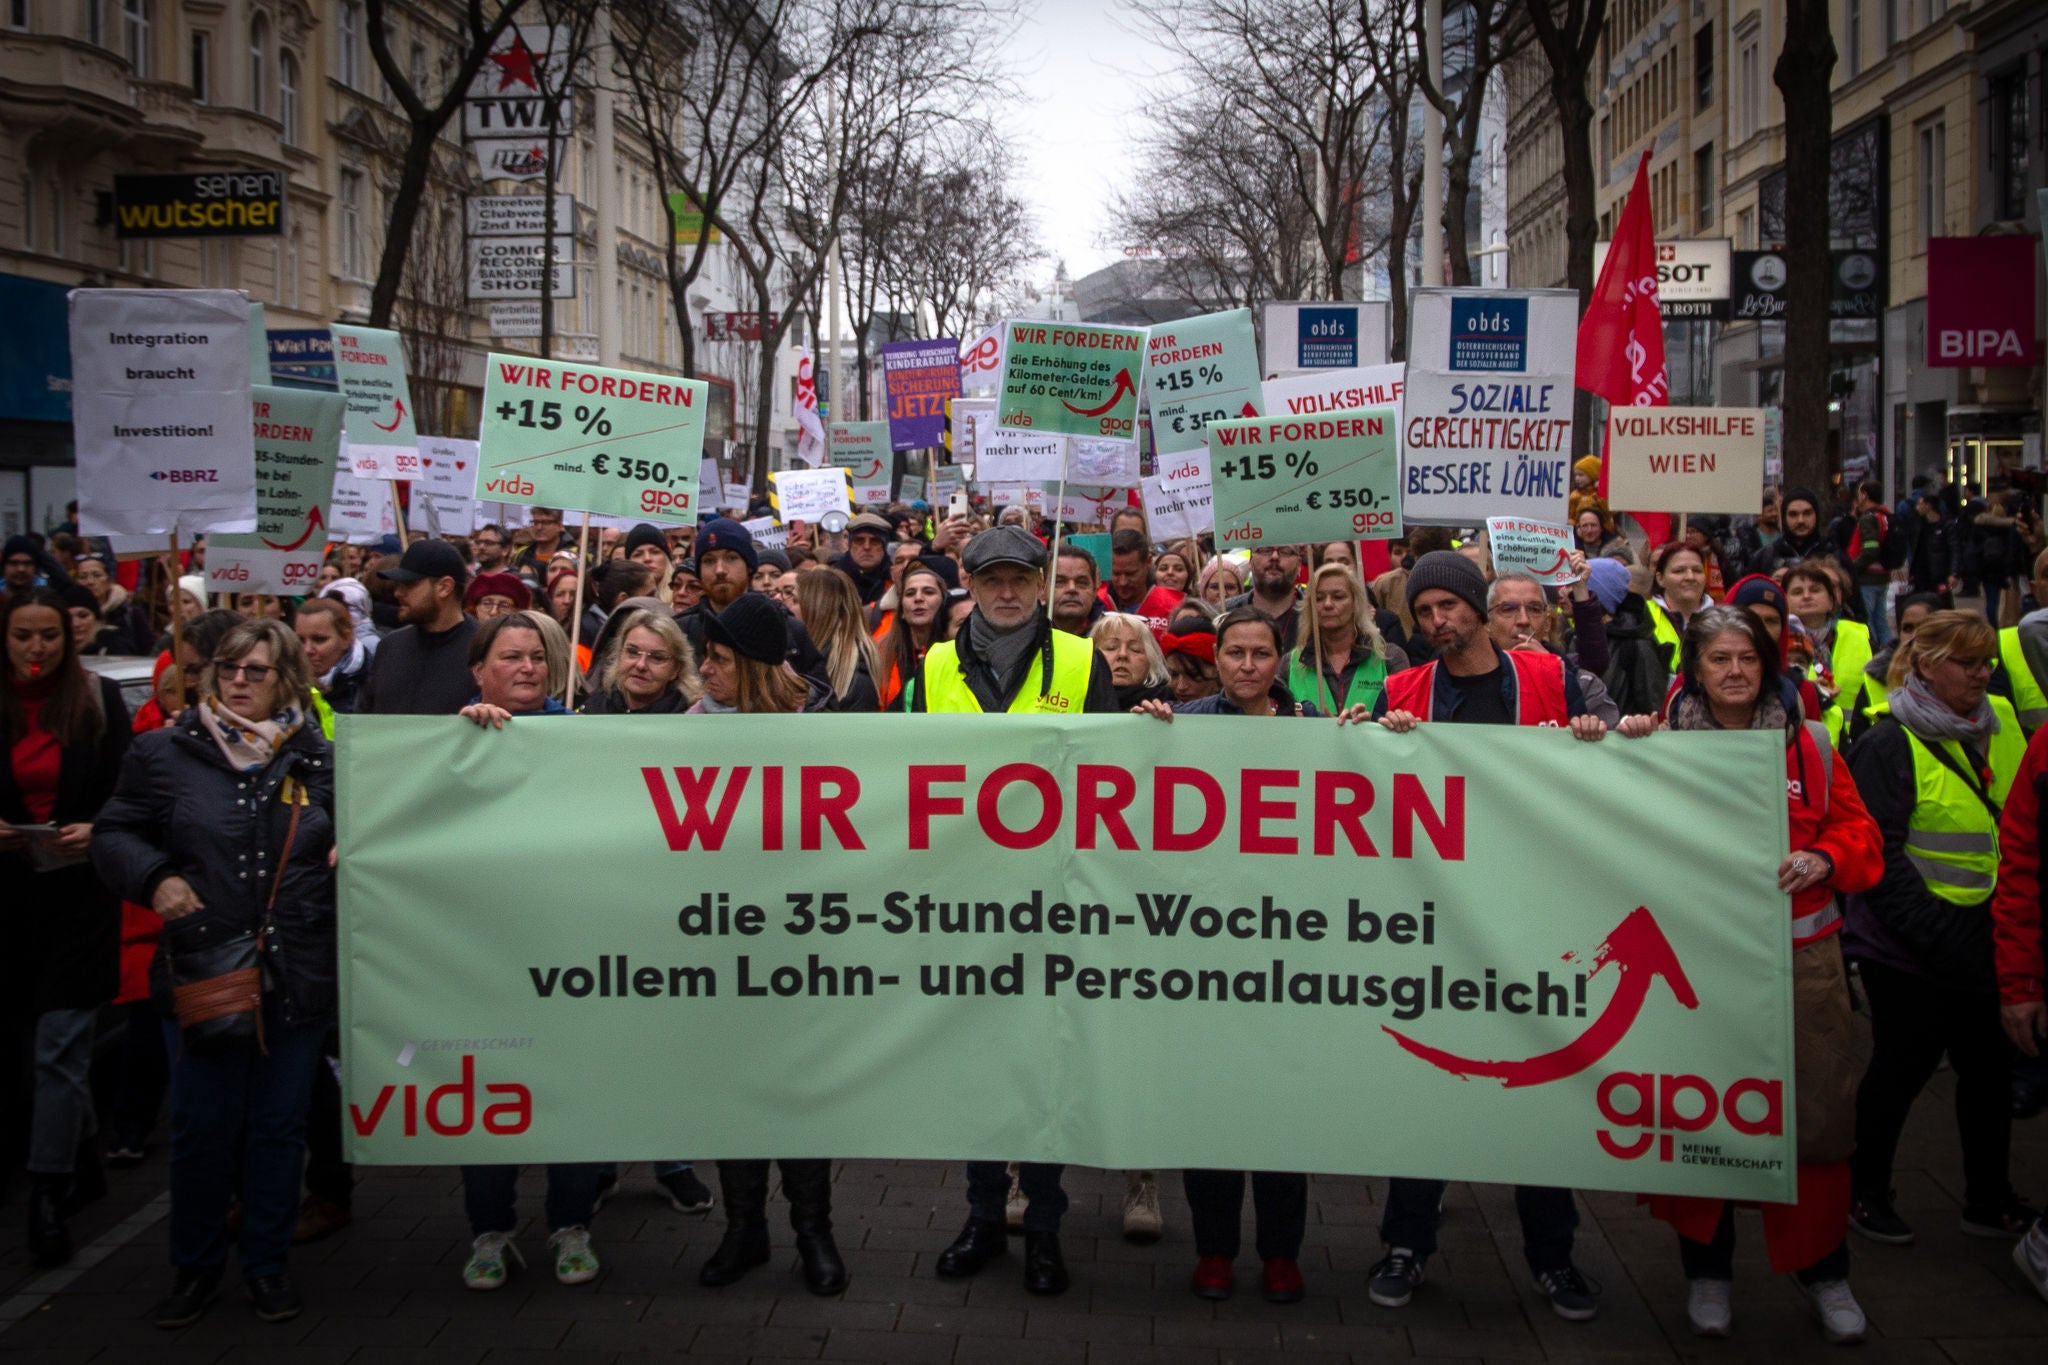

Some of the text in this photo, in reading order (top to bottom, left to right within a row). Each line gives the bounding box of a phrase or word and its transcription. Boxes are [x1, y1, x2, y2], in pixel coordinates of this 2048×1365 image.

[195, 172, 280, 198] sehen!
[119, 199, 279, 228] wutscher
[480, 221, 510, 230] 2nd
[481, 246, 559, 255] COMICS
[479, 269, 559, 278] BAND-SHIRS
[1657, 264, 1711, 282] SOT
[481, 281, 559, 290] SHOES
[1675, 303, 1712, 315] ROTH
[1311, 319, 1344, 335] obds
[1468, 312, 1510, 331] obds
[109, 333, 208, 347] Integration
[339, 336, 358, 347] WIR
[1013, 327, 1139, 351] WIR FORDERN
[1150, 335, 1176, 350] WIR
[1457, 341, 1519, 351] ÖSTERREICHISCHER
[1940, 329, 2023, 358] BIPA
[341, 350, 388, 366] FORDERN
[886, 355, 959, 370] KINDERARMUT.
[1010, 354, 1110, 372] die Erhöhung des
[1151, 342, 1223, 367] FORDERN
[1456, 351, 1519, 359] BERUFSVERBAND
[126, 368, 195, 379] braucht
[1456, 360, 1518, 369] DER SOZIALEN ARBEIT
[499, 363, 693, 408] WIR FORDERN
[888, 377, 960, 395] SICHERUNG
[1009, 369, 1110, 387] Kilometer-Geldes
[1156, 364, 1223, 391] +15 %
[1007, 384, 1102, 400] auf 60 Cent/km!
[1288, 382, 1403, 415] VOLKSHILF
[1449, 384, 1554, 414] SOZIALE
[496, 399, 612, 436] +15 %
[1159, 405, 1187, 417] mind.
[114, 425, 213, 437] Investition!
[1002, 410, 1132, 435] vida gpa
[1172, 417, 1184, 433] €
[1217, 417, 1383, 446] WIR FORDERN
[1615, 416, 1754, 437] VOLKSHILFE
[1408, 417, 1571, 452] GERECHTIGKEIT
[985, 443, 1057, 455] mehr wert!
[554, 462, 586, 474] mind.
[591, 453, 611, 475] €
[617, 456, 688, 488] 350,-
[1168, 462, 1200, 480] vida
[1221, 450, 1318, 481] +15 %
[1649, 454, 1716, 473] WIEN
[170, 470, 219, 483] BBRZ
[272, 471, 291, 482] bei
[1408, 455, 1566, 498] BESSERE LÖHNE
[269, 488, 302, 500] Lohn-
[485, 474, 689, 514] vida gpa
[1276, 488, 1389, 513] mind. € 350,-
[258, 506, 304, 518] ersonal-
[1155, 501, 1185, 515] mehr
[1223, 511, 1393, 542] vida gpa
[1493, 521, 1568, 538] WIR FORDERN
[1497, 543, 1555, 555] Erhöhung der
[1498, 554, 1537, 564] Gehälter!
[211, 563, 318, 585] vida gpa
[1037, 691, 1069, 708] vida
[640, 763, 1465, 861] WIR FORDERN
[678, 890, 1435, 945] die 35-Stunden-Woche bei
[528, 953, 1587, 1020] vollem Lohn- und Personalausgleich!
[421, 1037, 535, 1050] GEWERKSCHAFT
[349, 1054, 532, 1137] vida
[1596, 1071, 1783, 1162] gpa
[1682, 1144, 1721, 1155] MEINE
[1682, 1155, 1783, 1170] GEWERKSCHAFT
